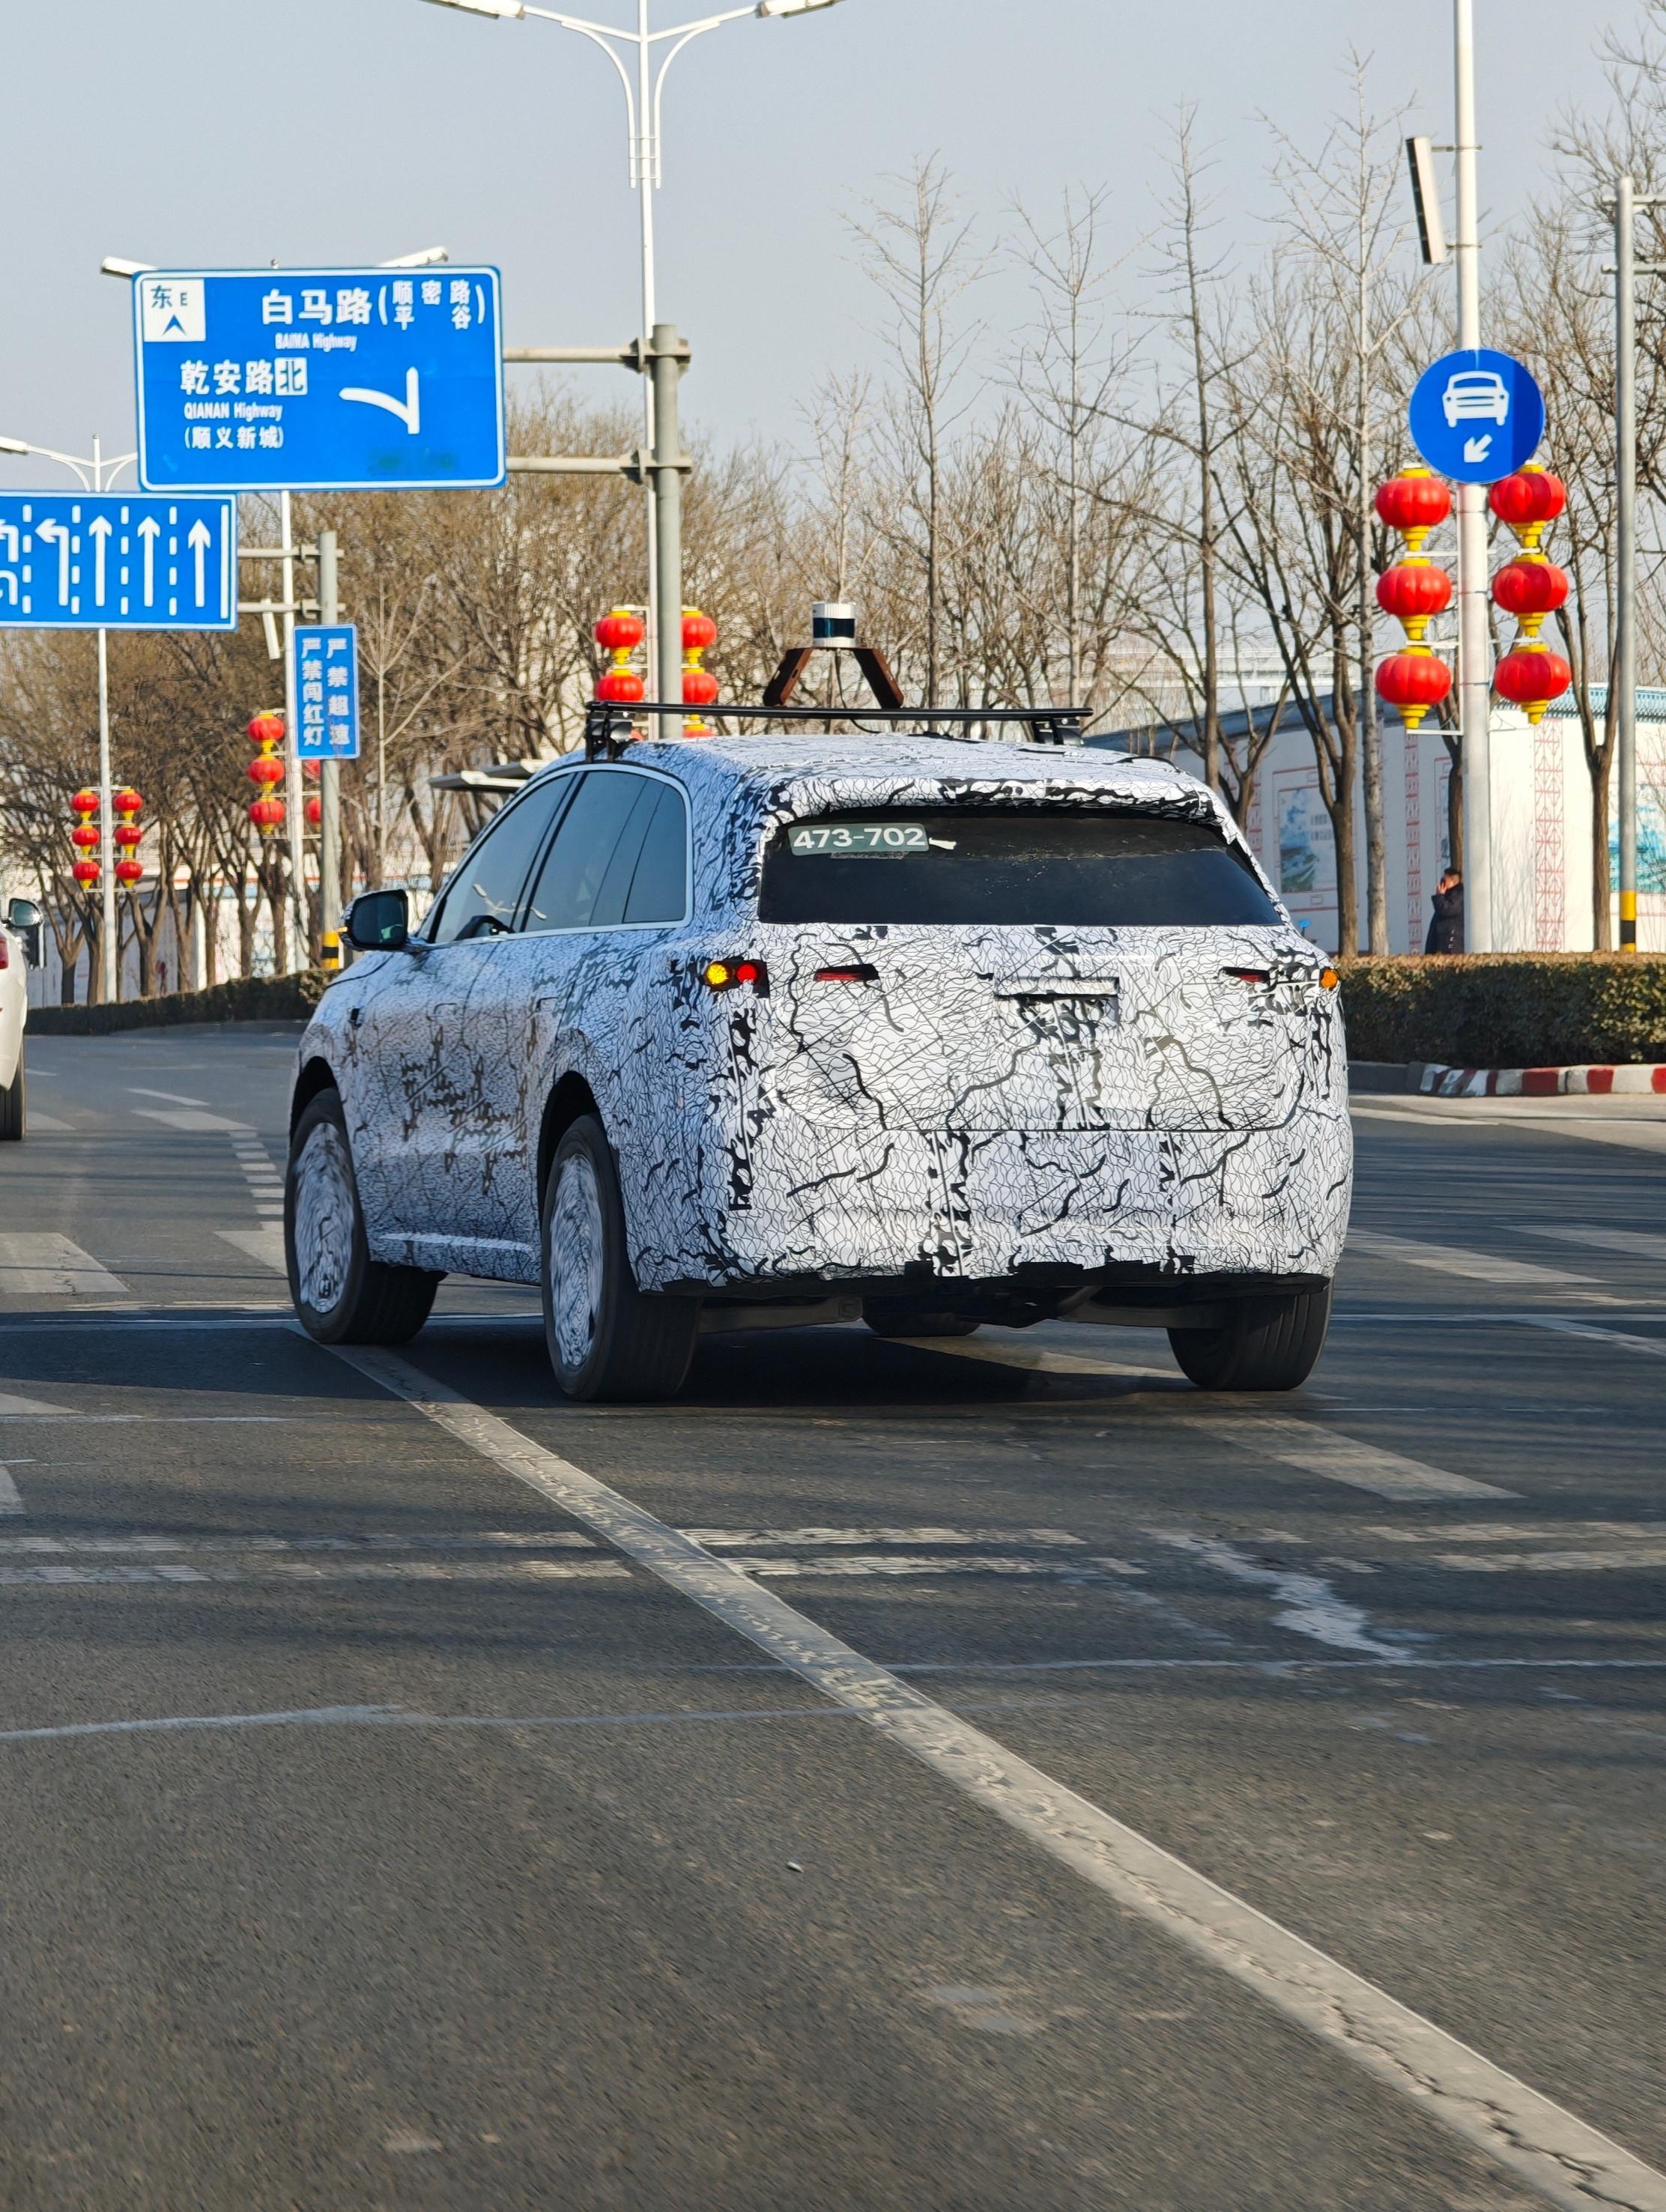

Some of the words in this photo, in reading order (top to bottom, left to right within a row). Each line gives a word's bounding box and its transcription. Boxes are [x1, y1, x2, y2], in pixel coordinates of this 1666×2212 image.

[151, 285, 172, 309] 东
[180, 291, 188, 307] E
[262, 287, 372, 325] 白马路
[275, 333, 310, 349] BAIMA
[312, 332, 357, 352] Highway
[184, 402, 230, 419] QIANAN
[234, 402, 283, 422] Highway
[326, 637, 351, 745] 严禁超速
[793, 828, 926, 849] 473-702
